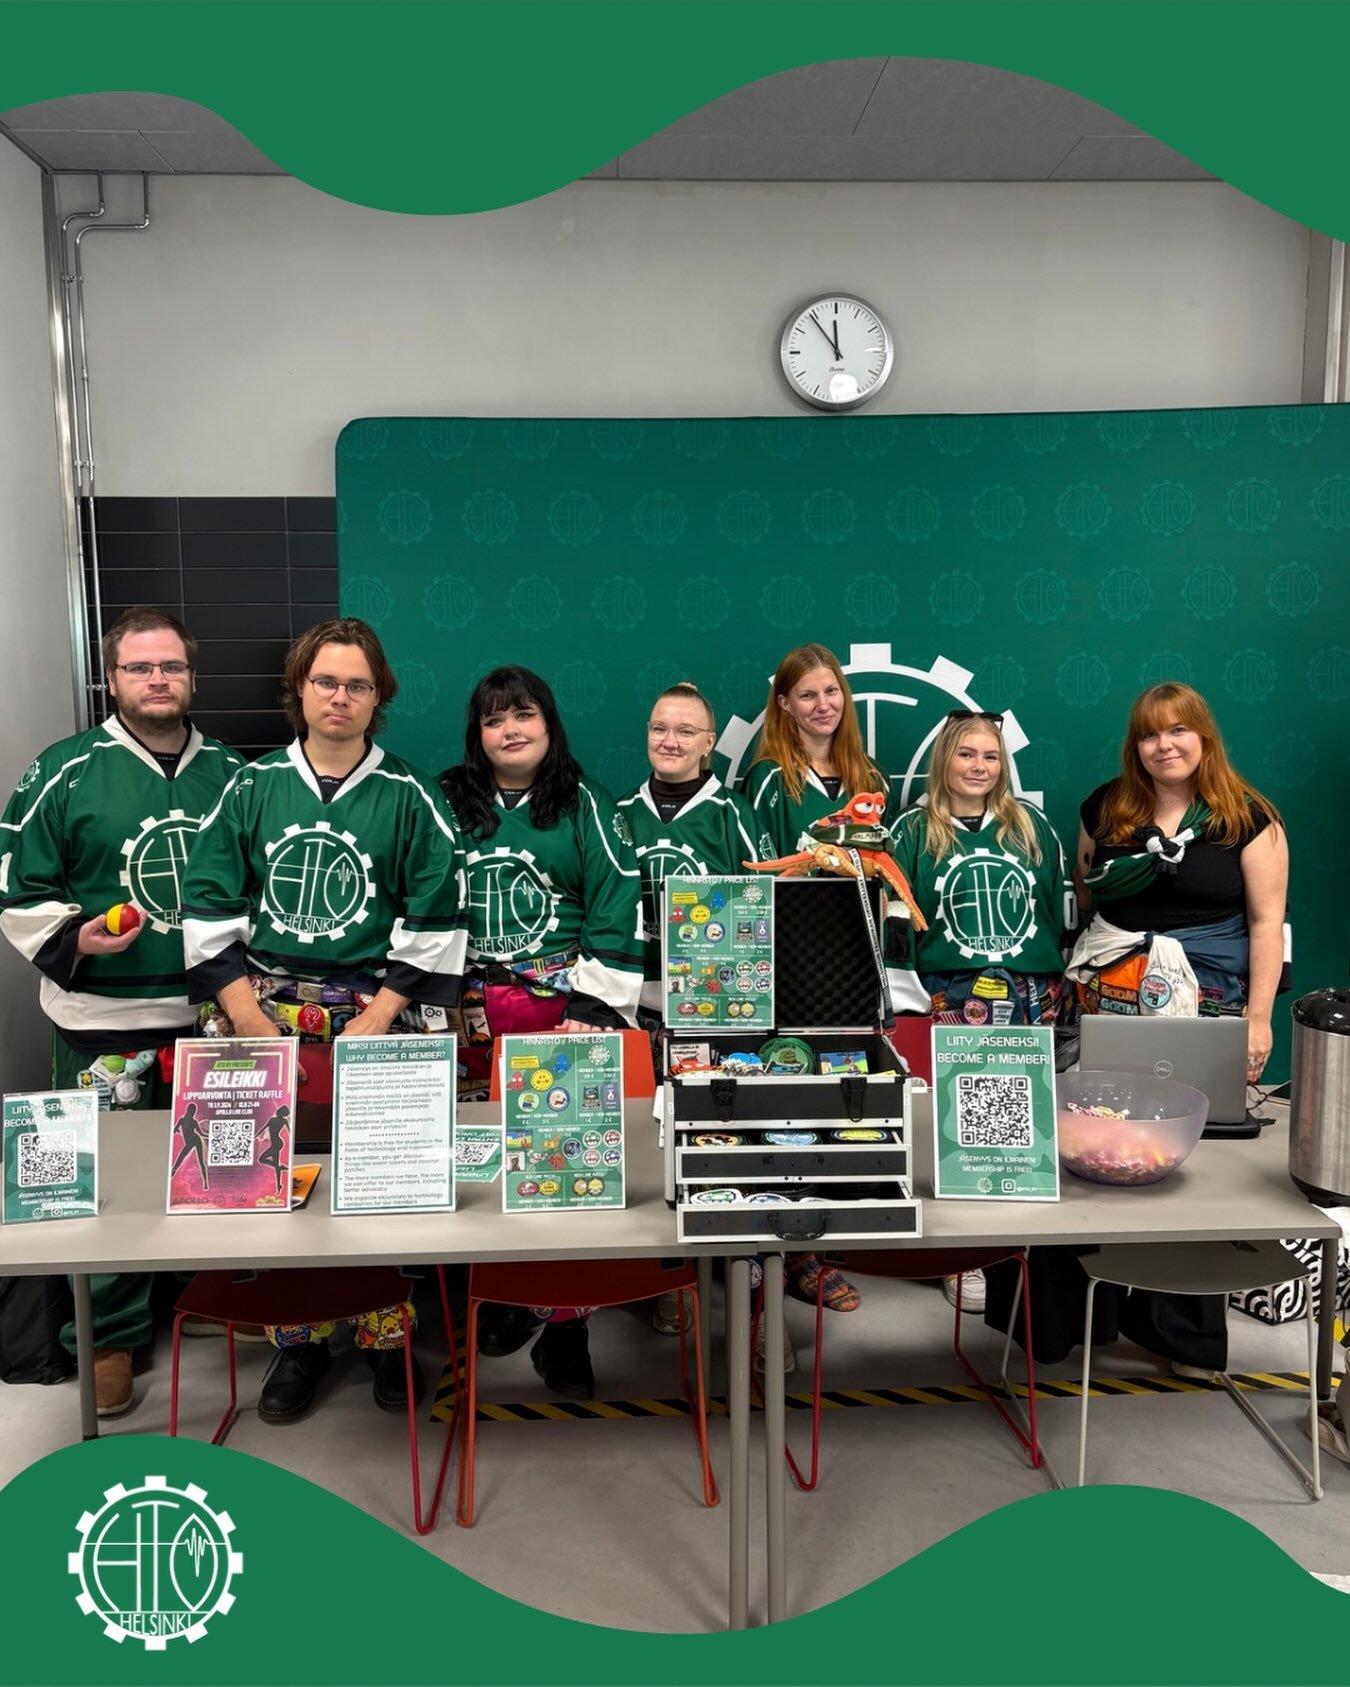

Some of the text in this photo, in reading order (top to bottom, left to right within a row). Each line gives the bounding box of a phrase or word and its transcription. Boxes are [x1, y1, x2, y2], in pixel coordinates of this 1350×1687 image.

[724, 876, 744, 884] PRICE
[859, 878, 872, 918] OPISKELIJAT
[283, 916, 336, 933] HELSINKI
[474, 934, 531, 953] HELSINKI
[968, 937, 1015, 952] HELSINKI
[523, 1037, 561, 1045] HINNASTO
[568, 1036, 590, 1044] PRICE
[947, 1036, 972, 1046] LIITY
[367, 1053, 398, 1061] BECOME
[937, 1053, 1050, 1064] BECOME A MEMBER!
[203, 1071, 268, 1088] ESILEIKKI
[236, 1091, 257, 1099] TICKET
[259, 1091, 283, 1099] RAFFLE
